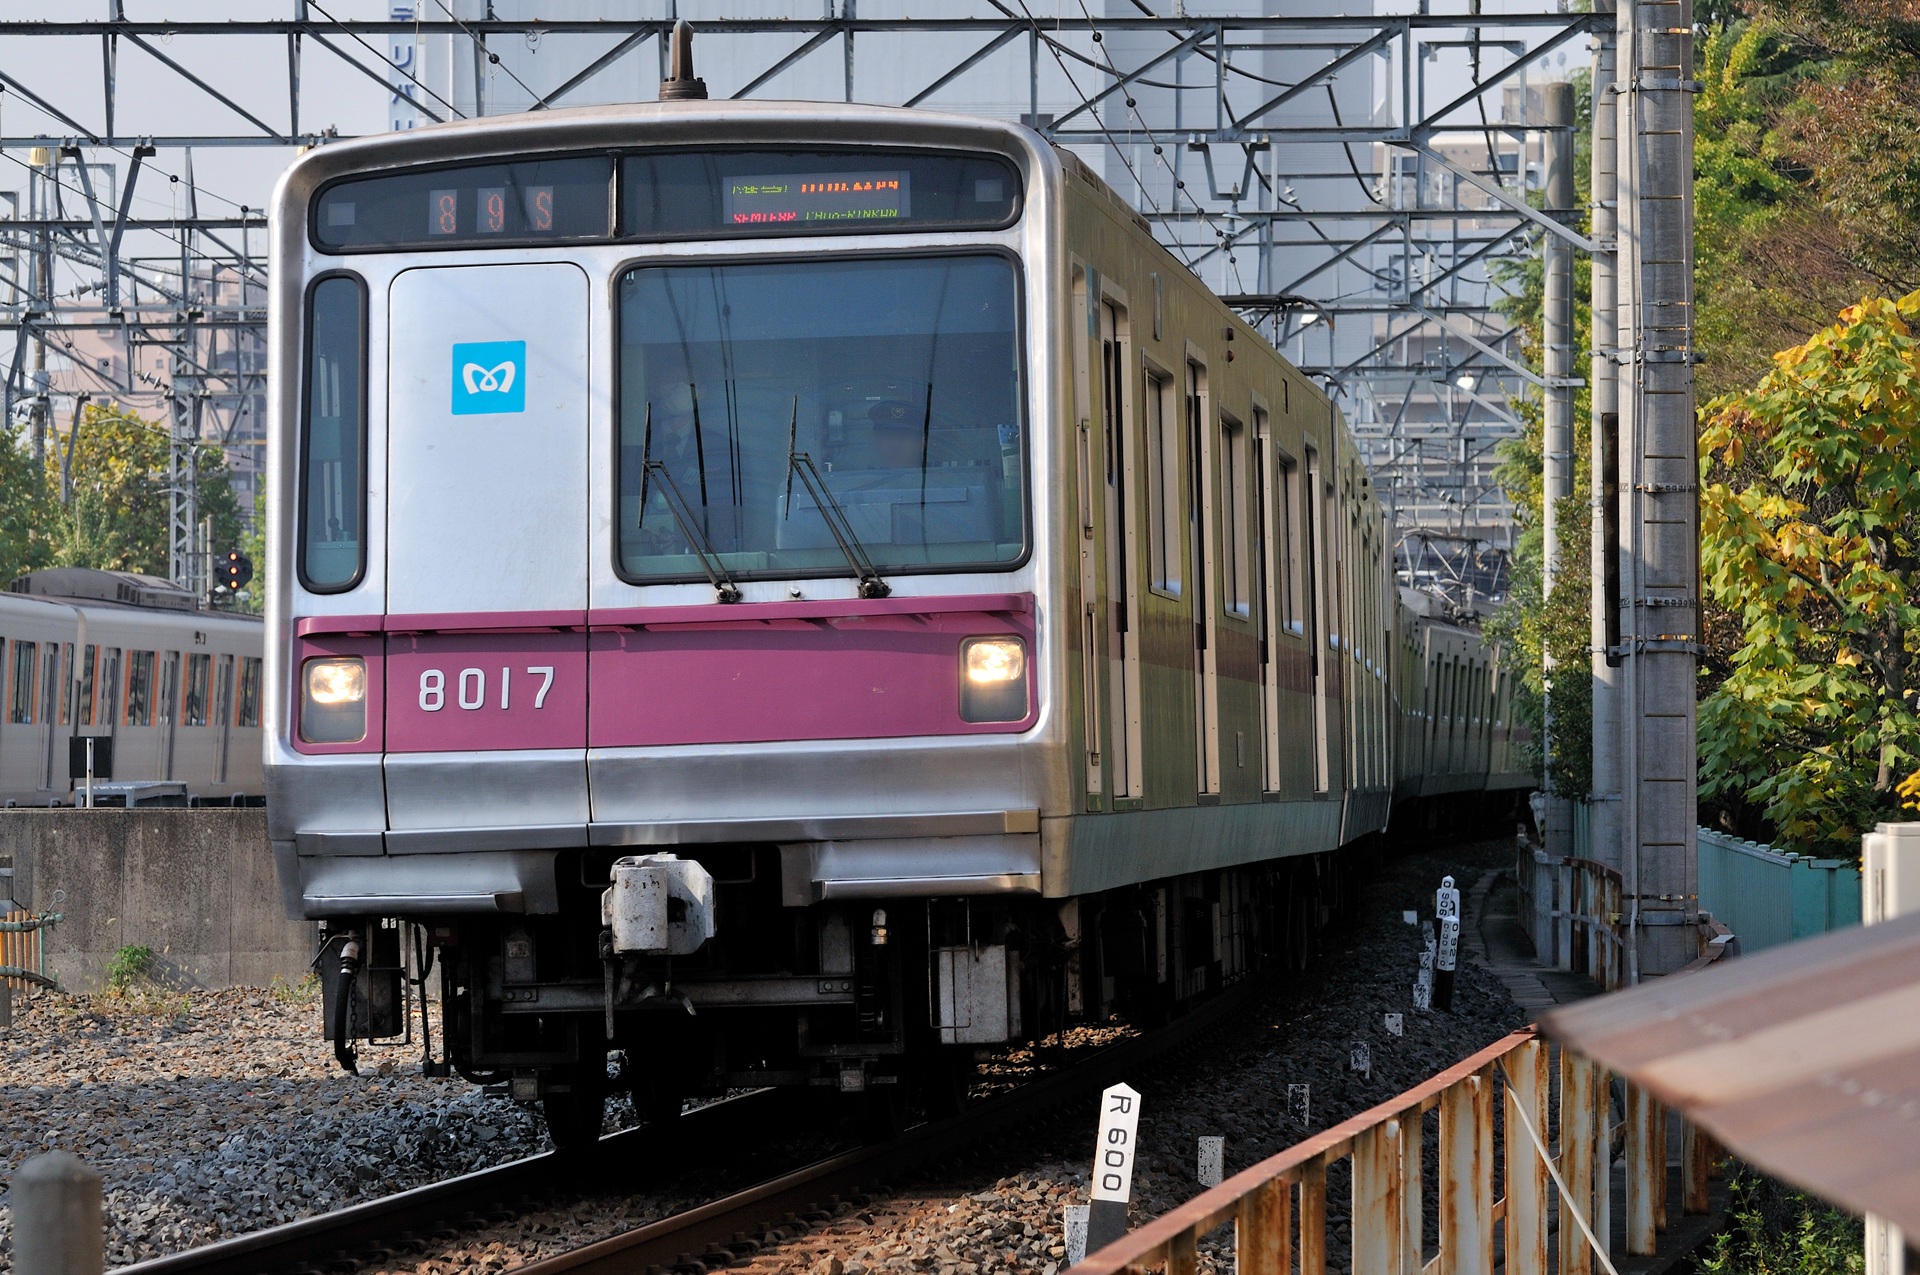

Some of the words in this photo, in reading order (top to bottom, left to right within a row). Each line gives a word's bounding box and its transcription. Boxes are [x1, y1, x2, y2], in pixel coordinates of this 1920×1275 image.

[418, 665, 555, 712] 8017
[1110, 1095, 1132, 1114] R
[1102, 1127, 1128, 1191] 600
